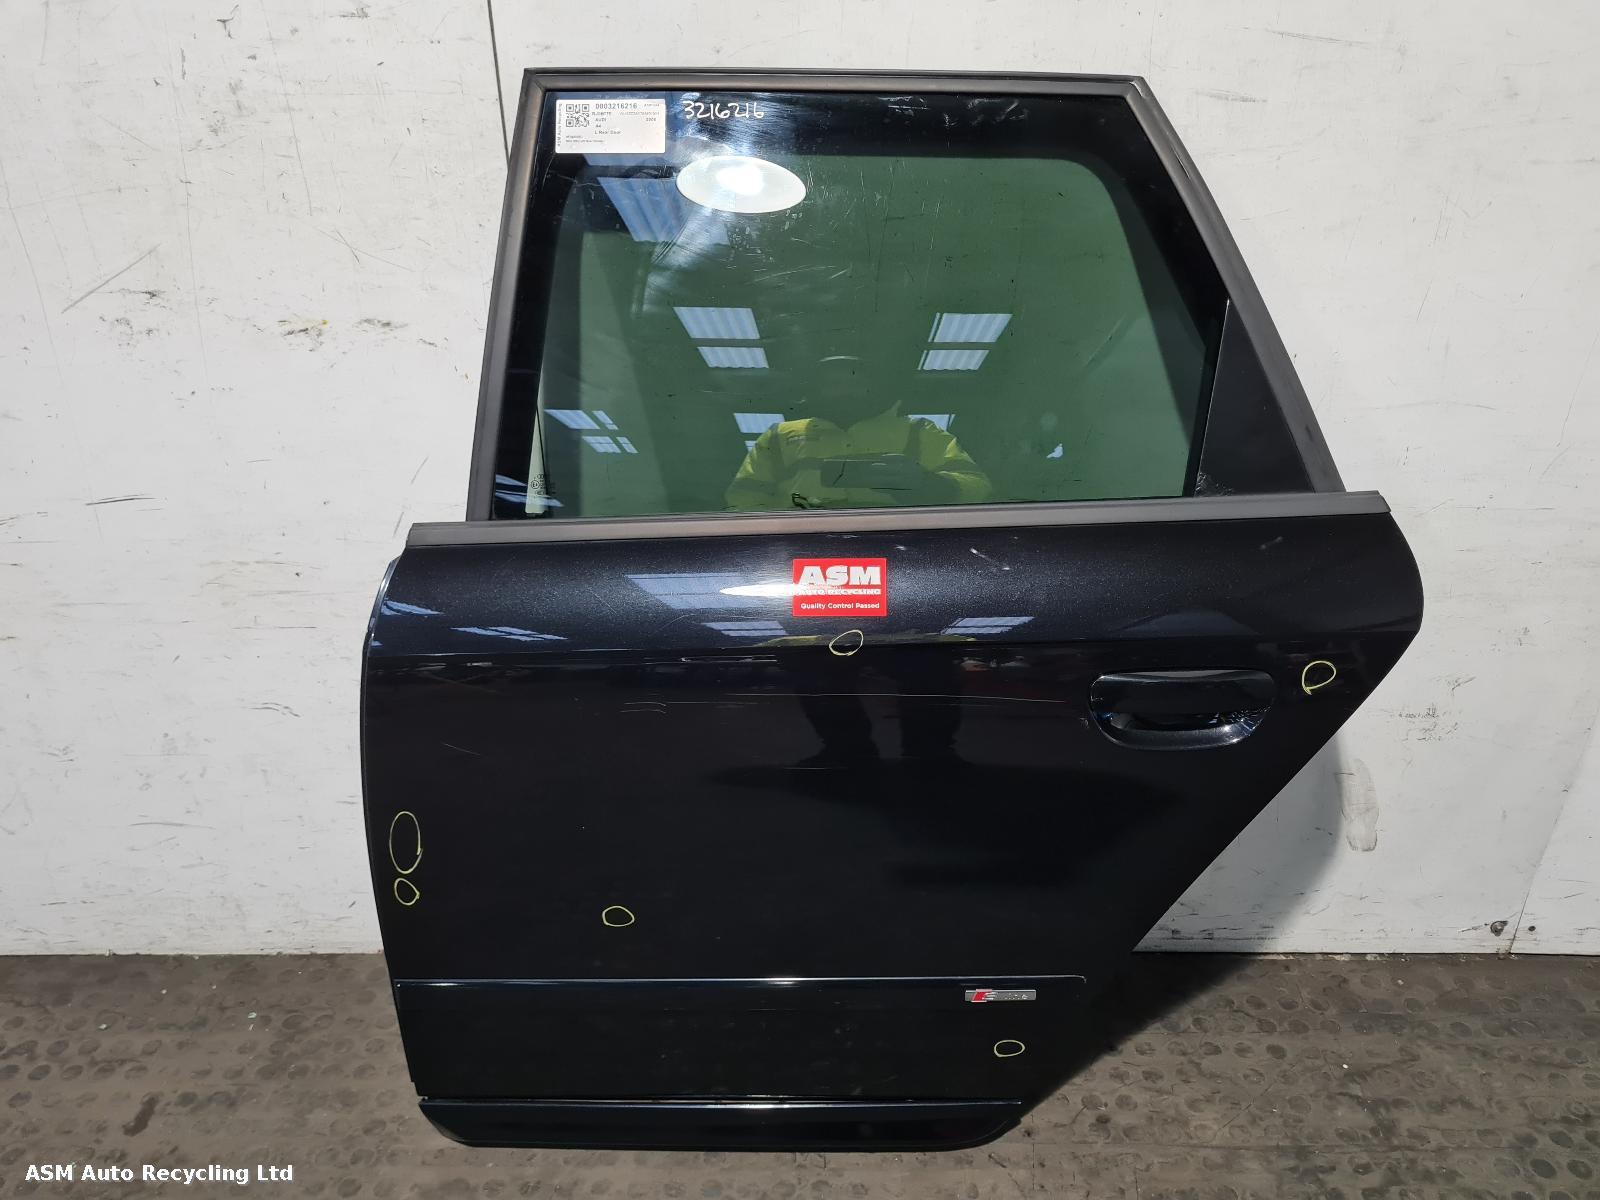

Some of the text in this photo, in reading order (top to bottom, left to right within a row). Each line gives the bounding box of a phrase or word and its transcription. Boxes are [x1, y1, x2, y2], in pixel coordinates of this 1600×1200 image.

[682, 100, 764, 120] 3216216
[799, 565, 881, 586] ASM
[800, 602, 826, 610] Quality
